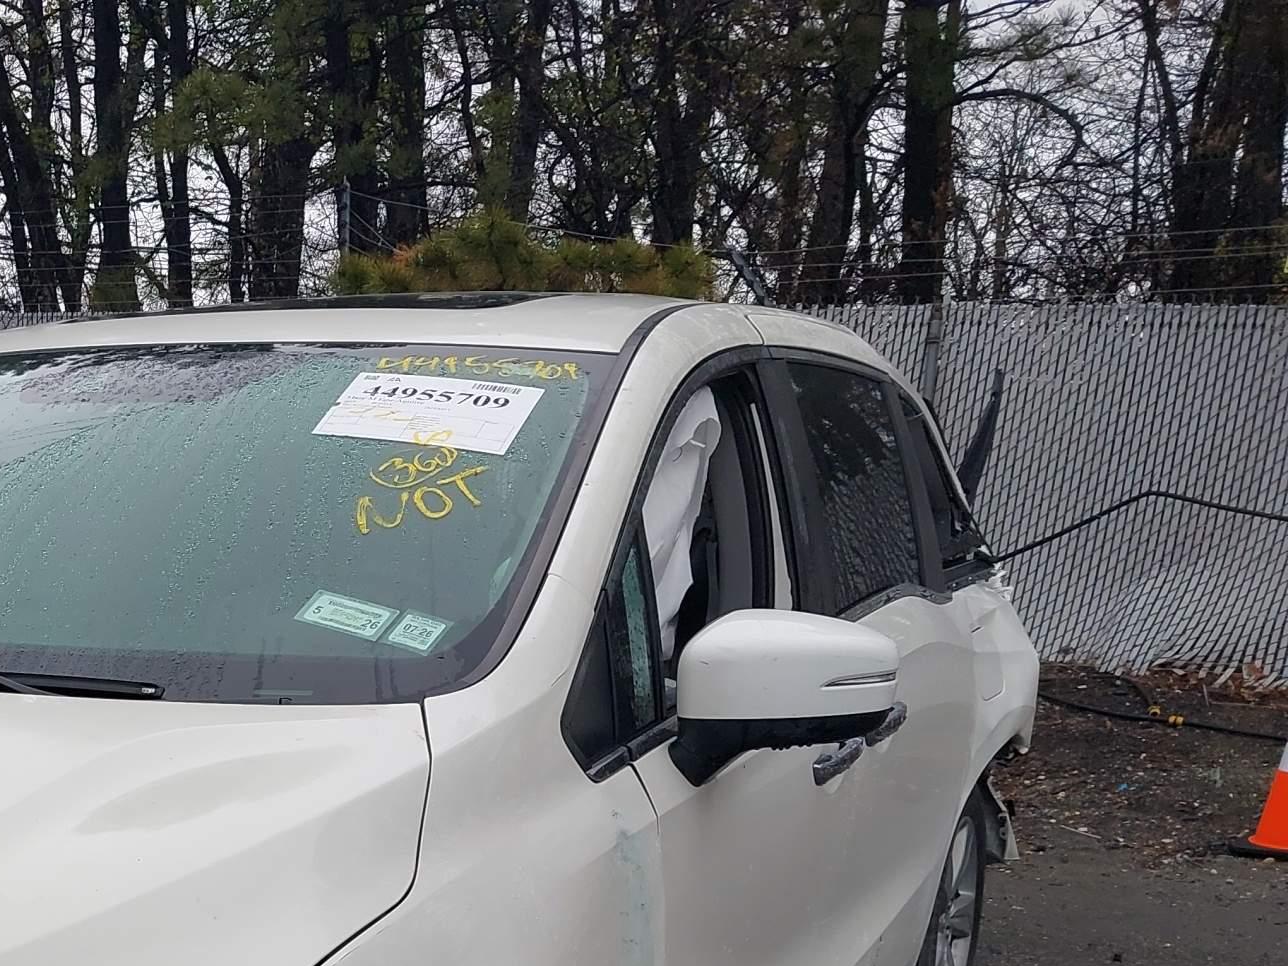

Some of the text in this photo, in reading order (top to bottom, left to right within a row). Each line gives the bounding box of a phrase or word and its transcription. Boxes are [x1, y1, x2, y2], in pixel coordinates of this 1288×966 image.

[363, 384, 511, 409] 44955709
[357, 465, 489, 535] NOT
[312, 605, 324, 615] 5
[360, 618, 381, 630] 26
[403, 623, 434, 638] 07-26
